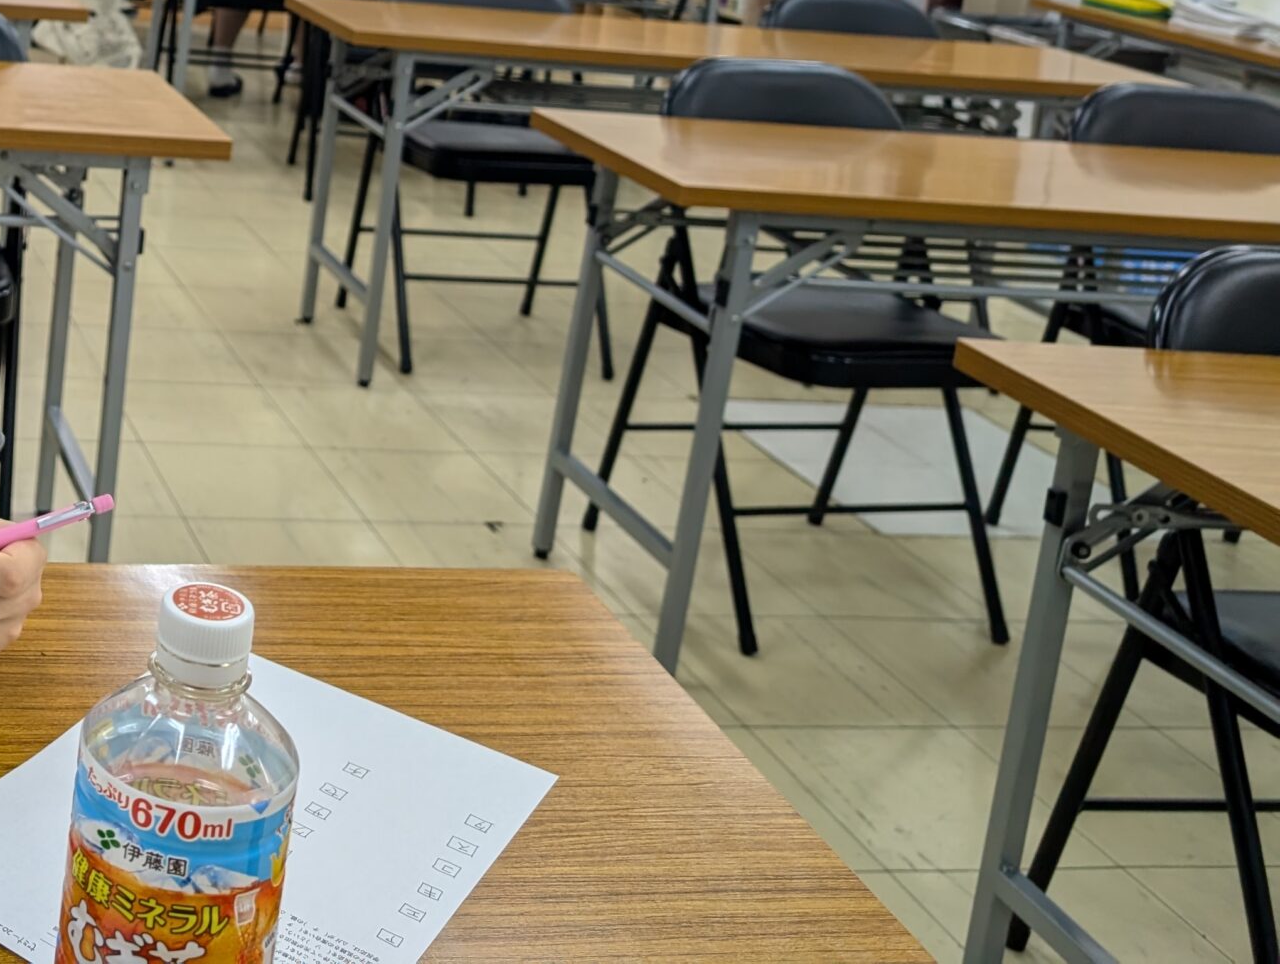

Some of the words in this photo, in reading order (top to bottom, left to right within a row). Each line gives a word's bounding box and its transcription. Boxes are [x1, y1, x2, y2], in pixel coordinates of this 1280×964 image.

[122, 842, 188, 877] 伊藤園
[72, 847, 228, 936] 健康ミネラル
